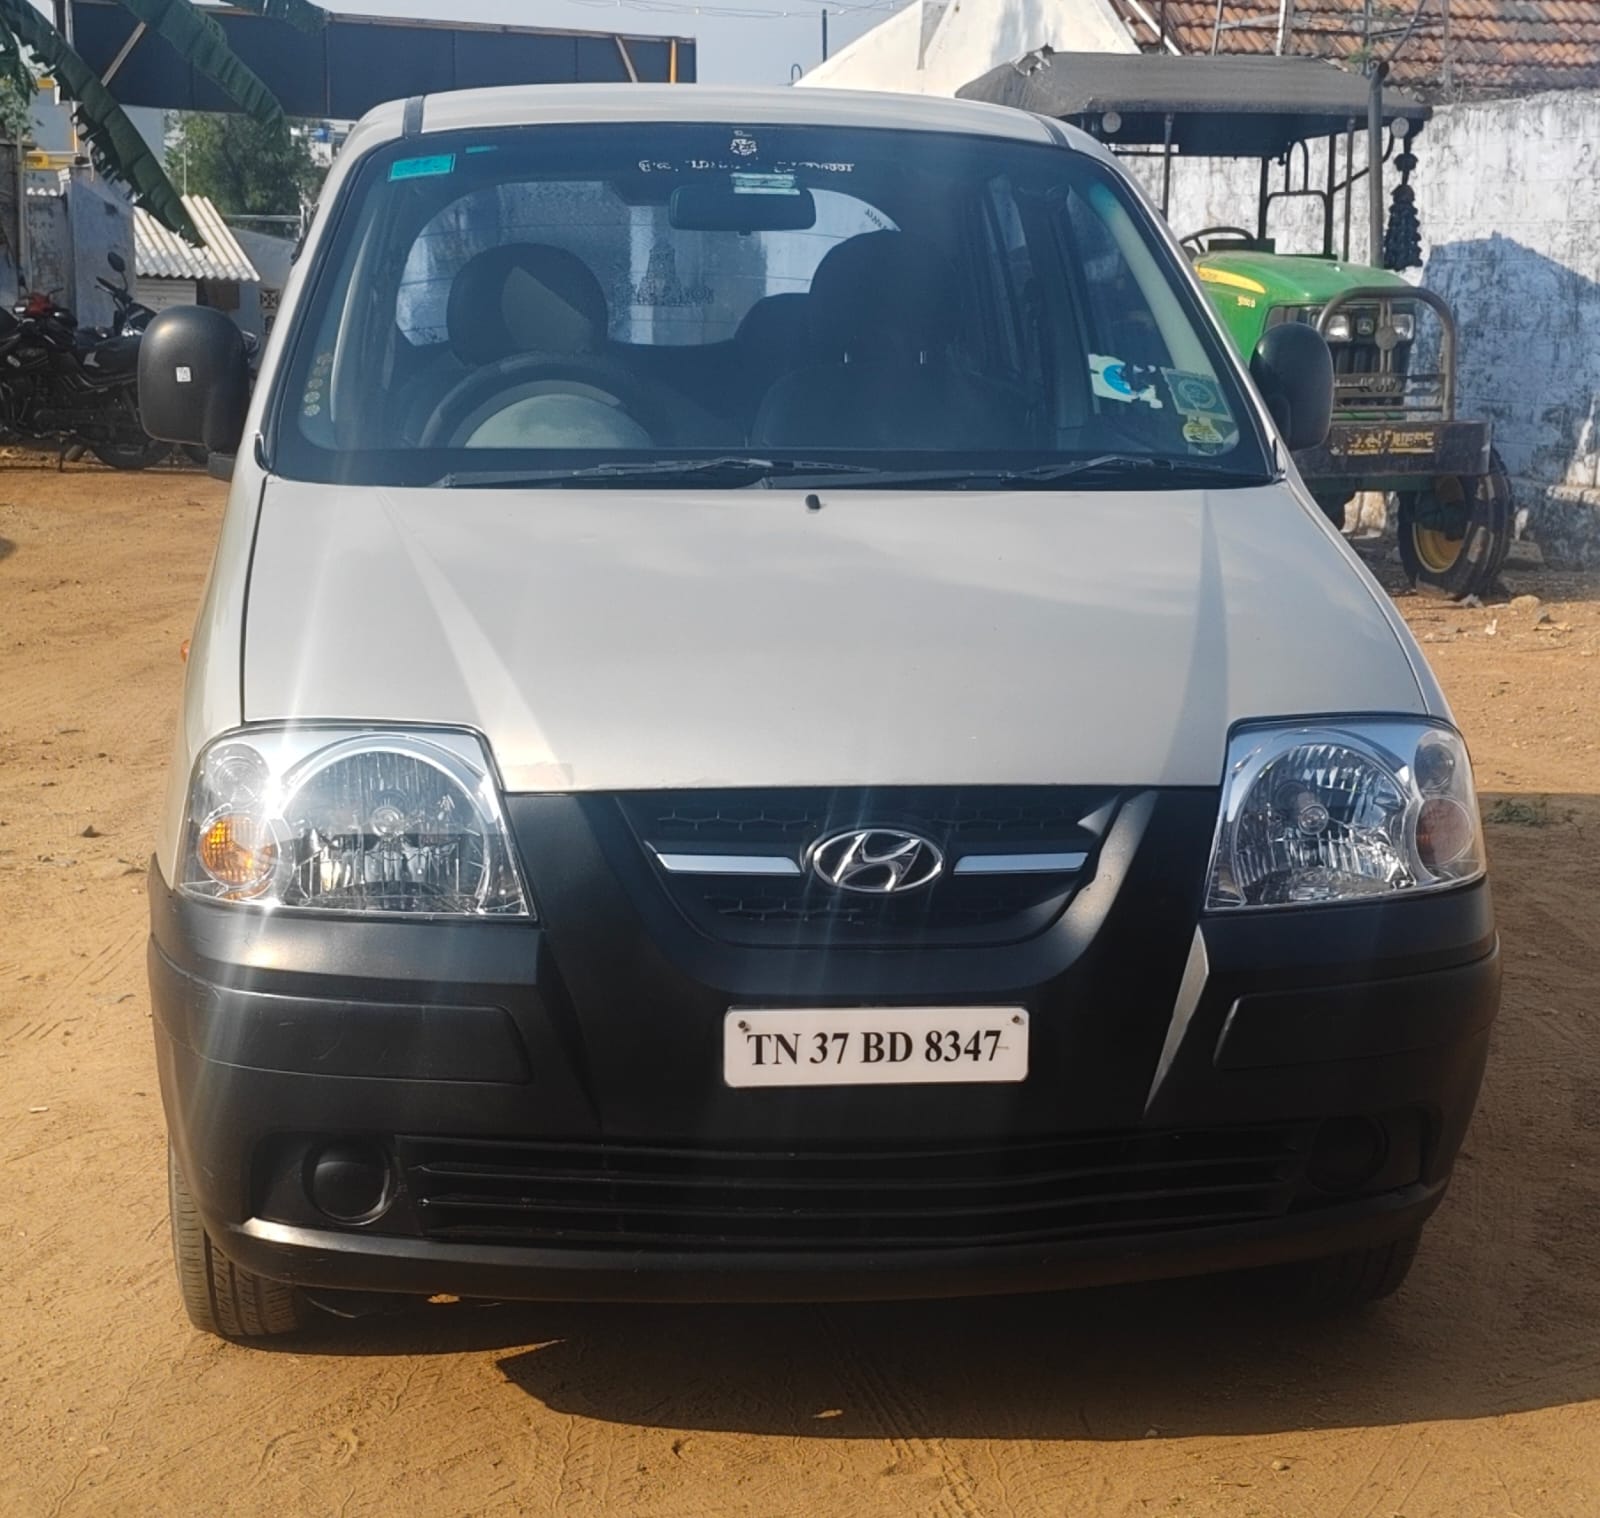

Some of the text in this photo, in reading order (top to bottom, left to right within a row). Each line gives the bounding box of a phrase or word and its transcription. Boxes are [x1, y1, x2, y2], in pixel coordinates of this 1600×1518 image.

[746, 1030, 1002, 1065] TN 37 BD 8347
